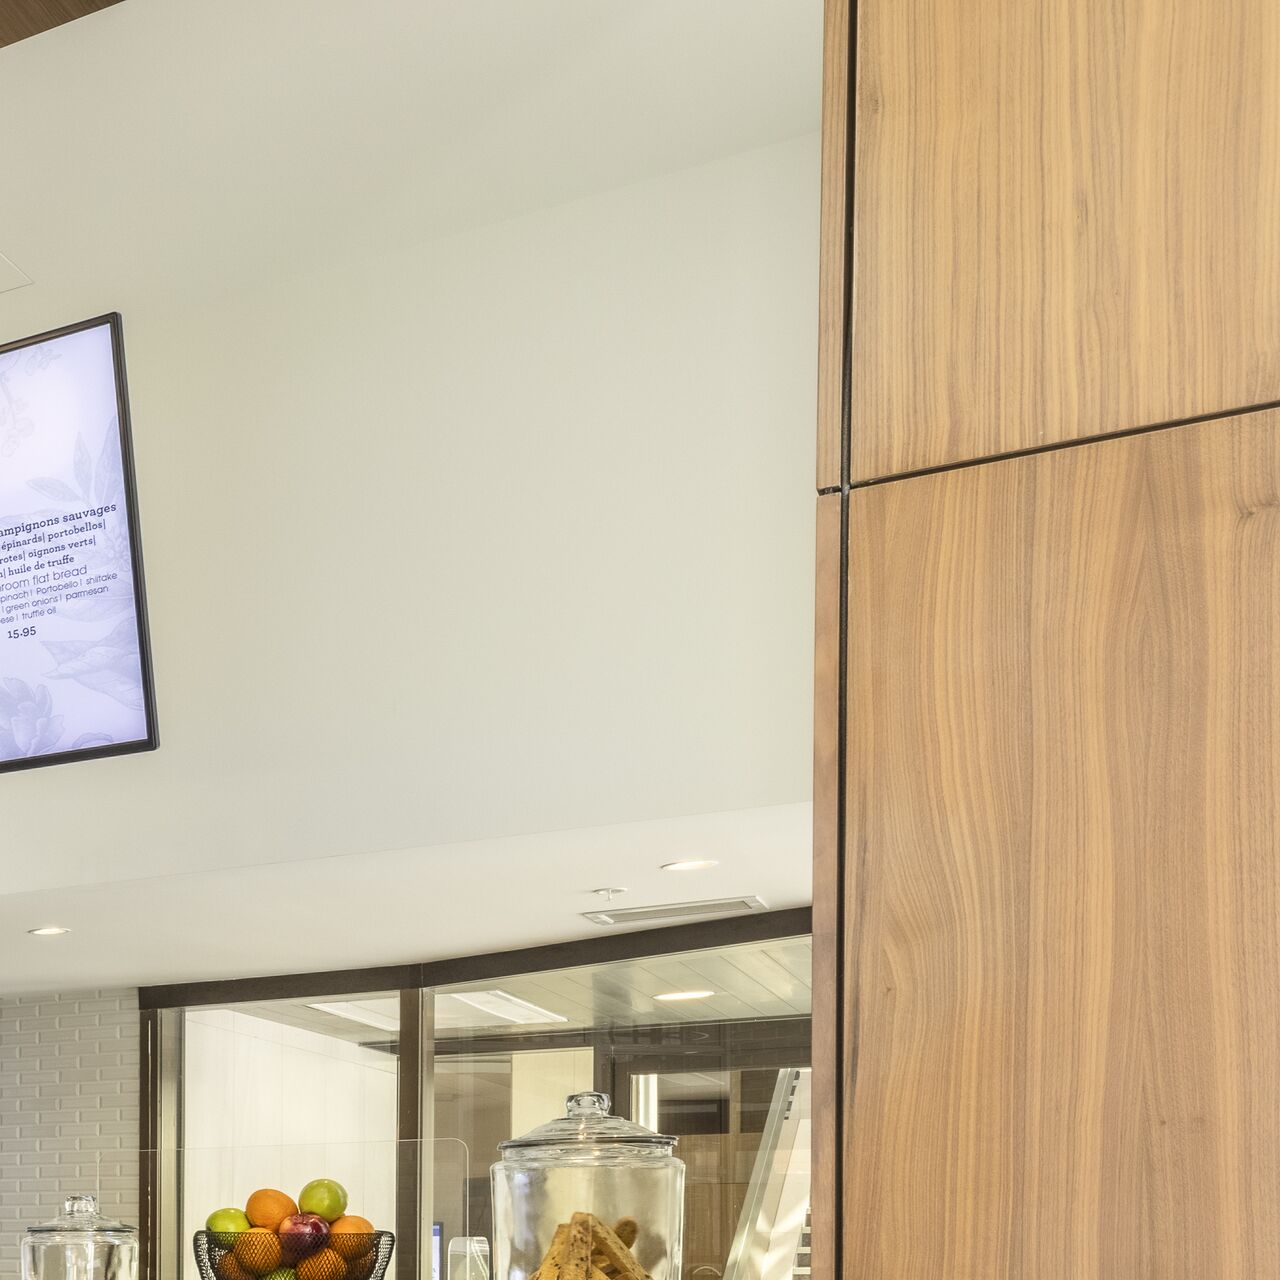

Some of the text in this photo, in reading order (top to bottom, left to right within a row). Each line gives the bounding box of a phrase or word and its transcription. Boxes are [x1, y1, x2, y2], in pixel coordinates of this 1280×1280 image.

[62, 503, 117, 523] sauvages
[32, 572, 50, 586] flat
[52, 564, 88, 581] bread
[7, 625, 37, 640] 15.95
